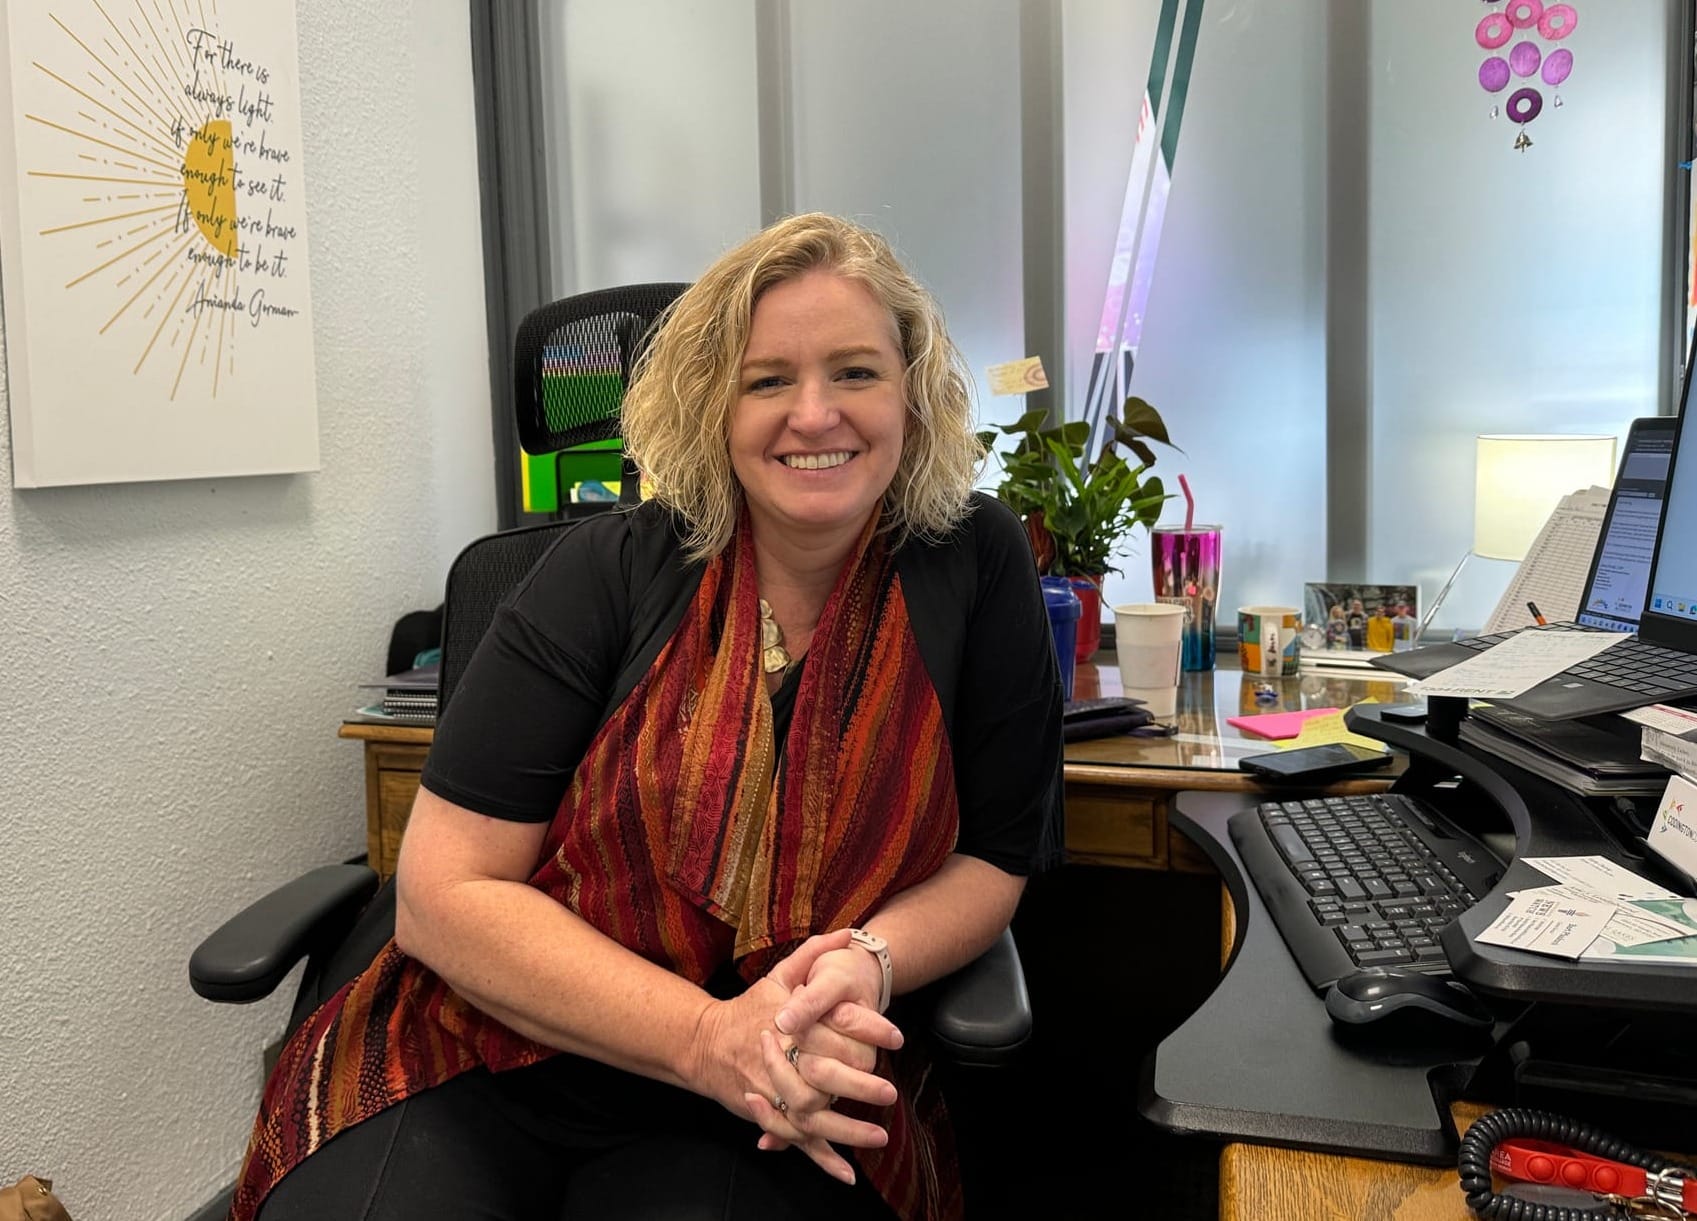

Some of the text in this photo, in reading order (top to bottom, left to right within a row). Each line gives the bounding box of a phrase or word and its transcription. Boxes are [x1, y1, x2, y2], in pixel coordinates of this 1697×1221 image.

[186, 28, 270, 84] For there is
[184, 70, 235, 118] always
[190, 112, 220, 156] only
[223, 131, 257, 154] we're
[259, 129, 290, 162] brave
[180, 158, 229, 196] enough
[227, 162, 245, 191] to
[248, 180, 268, 196] see
[175, 189, 297, 240] If only we're brave
[188, 240, 235, 278] enough
[235, 242, 252, 272] to
[254, 244, 269, 274] be
[186, 278, 299, 328] Amanda Gorman
